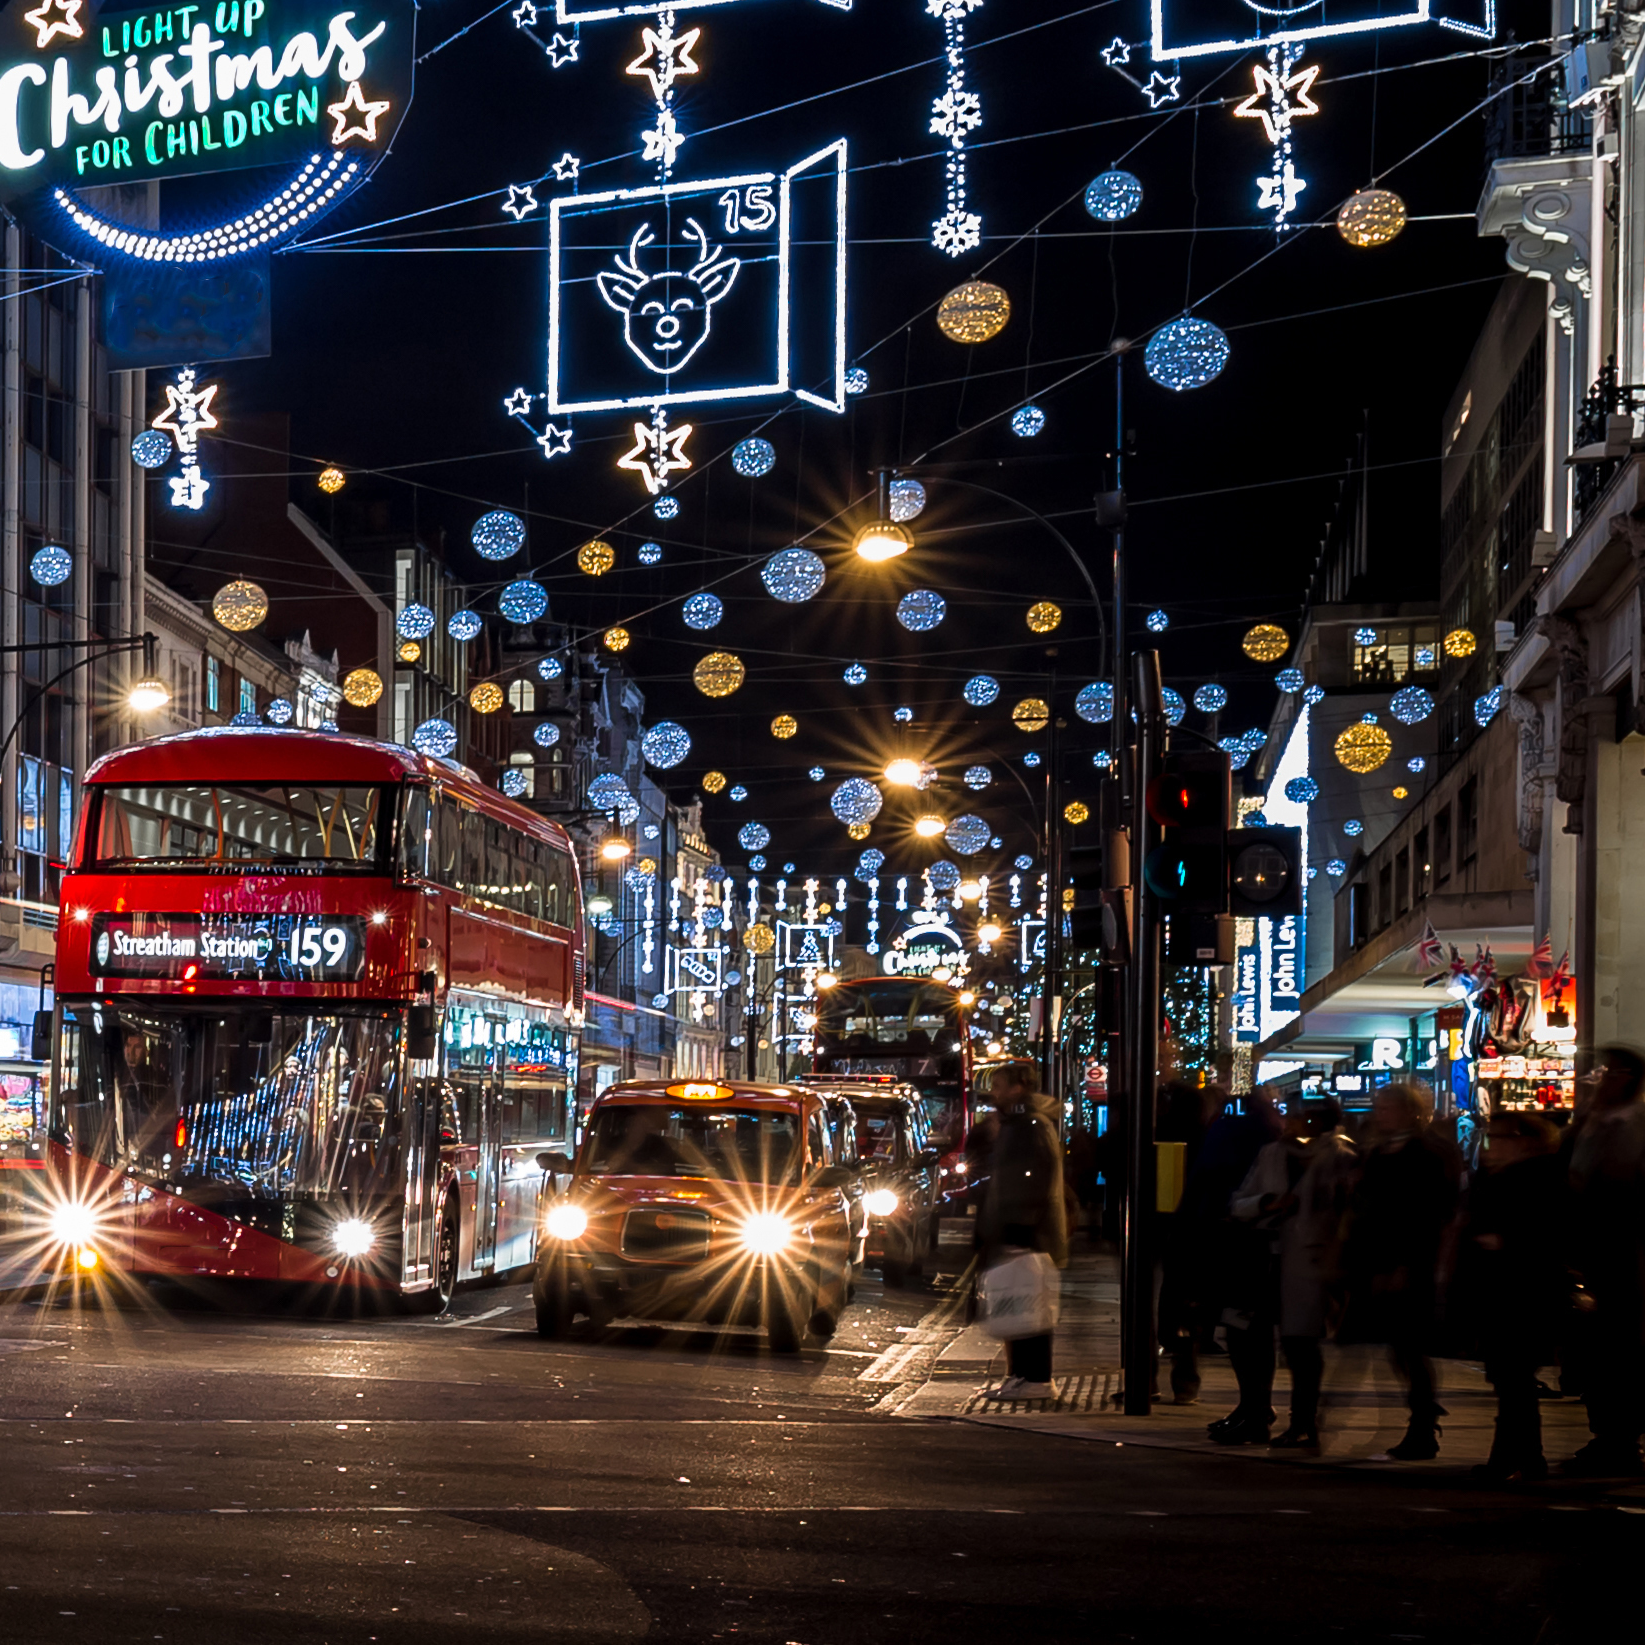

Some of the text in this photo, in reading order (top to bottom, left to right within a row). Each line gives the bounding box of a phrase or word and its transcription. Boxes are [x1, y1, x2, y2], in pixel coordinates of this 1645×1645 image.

[103, 4, 197, 58] LIGHT
[75, 86, 320, 176] FOR CHILDREN
[718, 185, 777, 234] 15
[113, 929, 196, 957] Streatham
[200, 931, 259, 958] Station
[290, 927, 347, 967] 159
[1238, 953, 1256, 995] Lewis
[1272, 953, 1300, 999] John
[917, 1059, 930, 1075] 7
